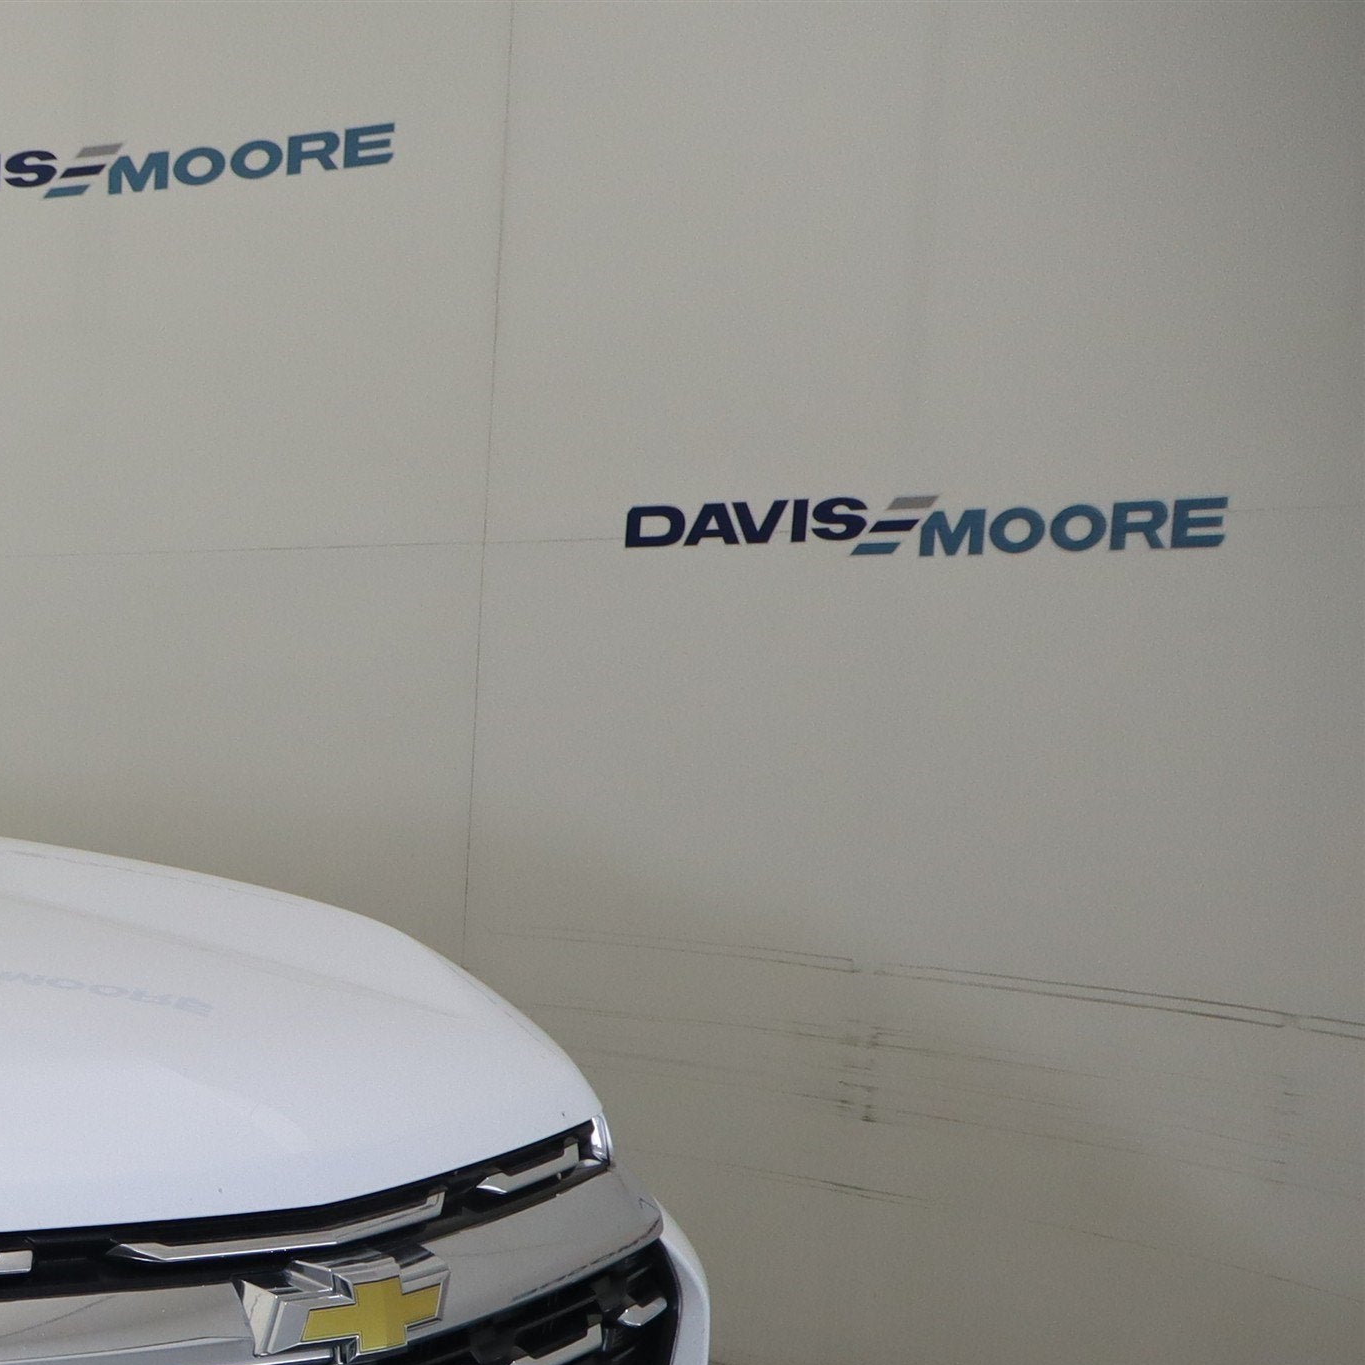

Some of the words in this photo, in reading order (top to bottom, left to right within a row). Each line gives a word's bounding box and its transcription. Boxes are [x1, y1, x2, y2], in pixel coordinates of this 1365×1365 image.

[108, 122, 395, 195] MOORE
[625, 497, 868, 548] DAVIS
[918, 497, 1229, 556] MOORE
